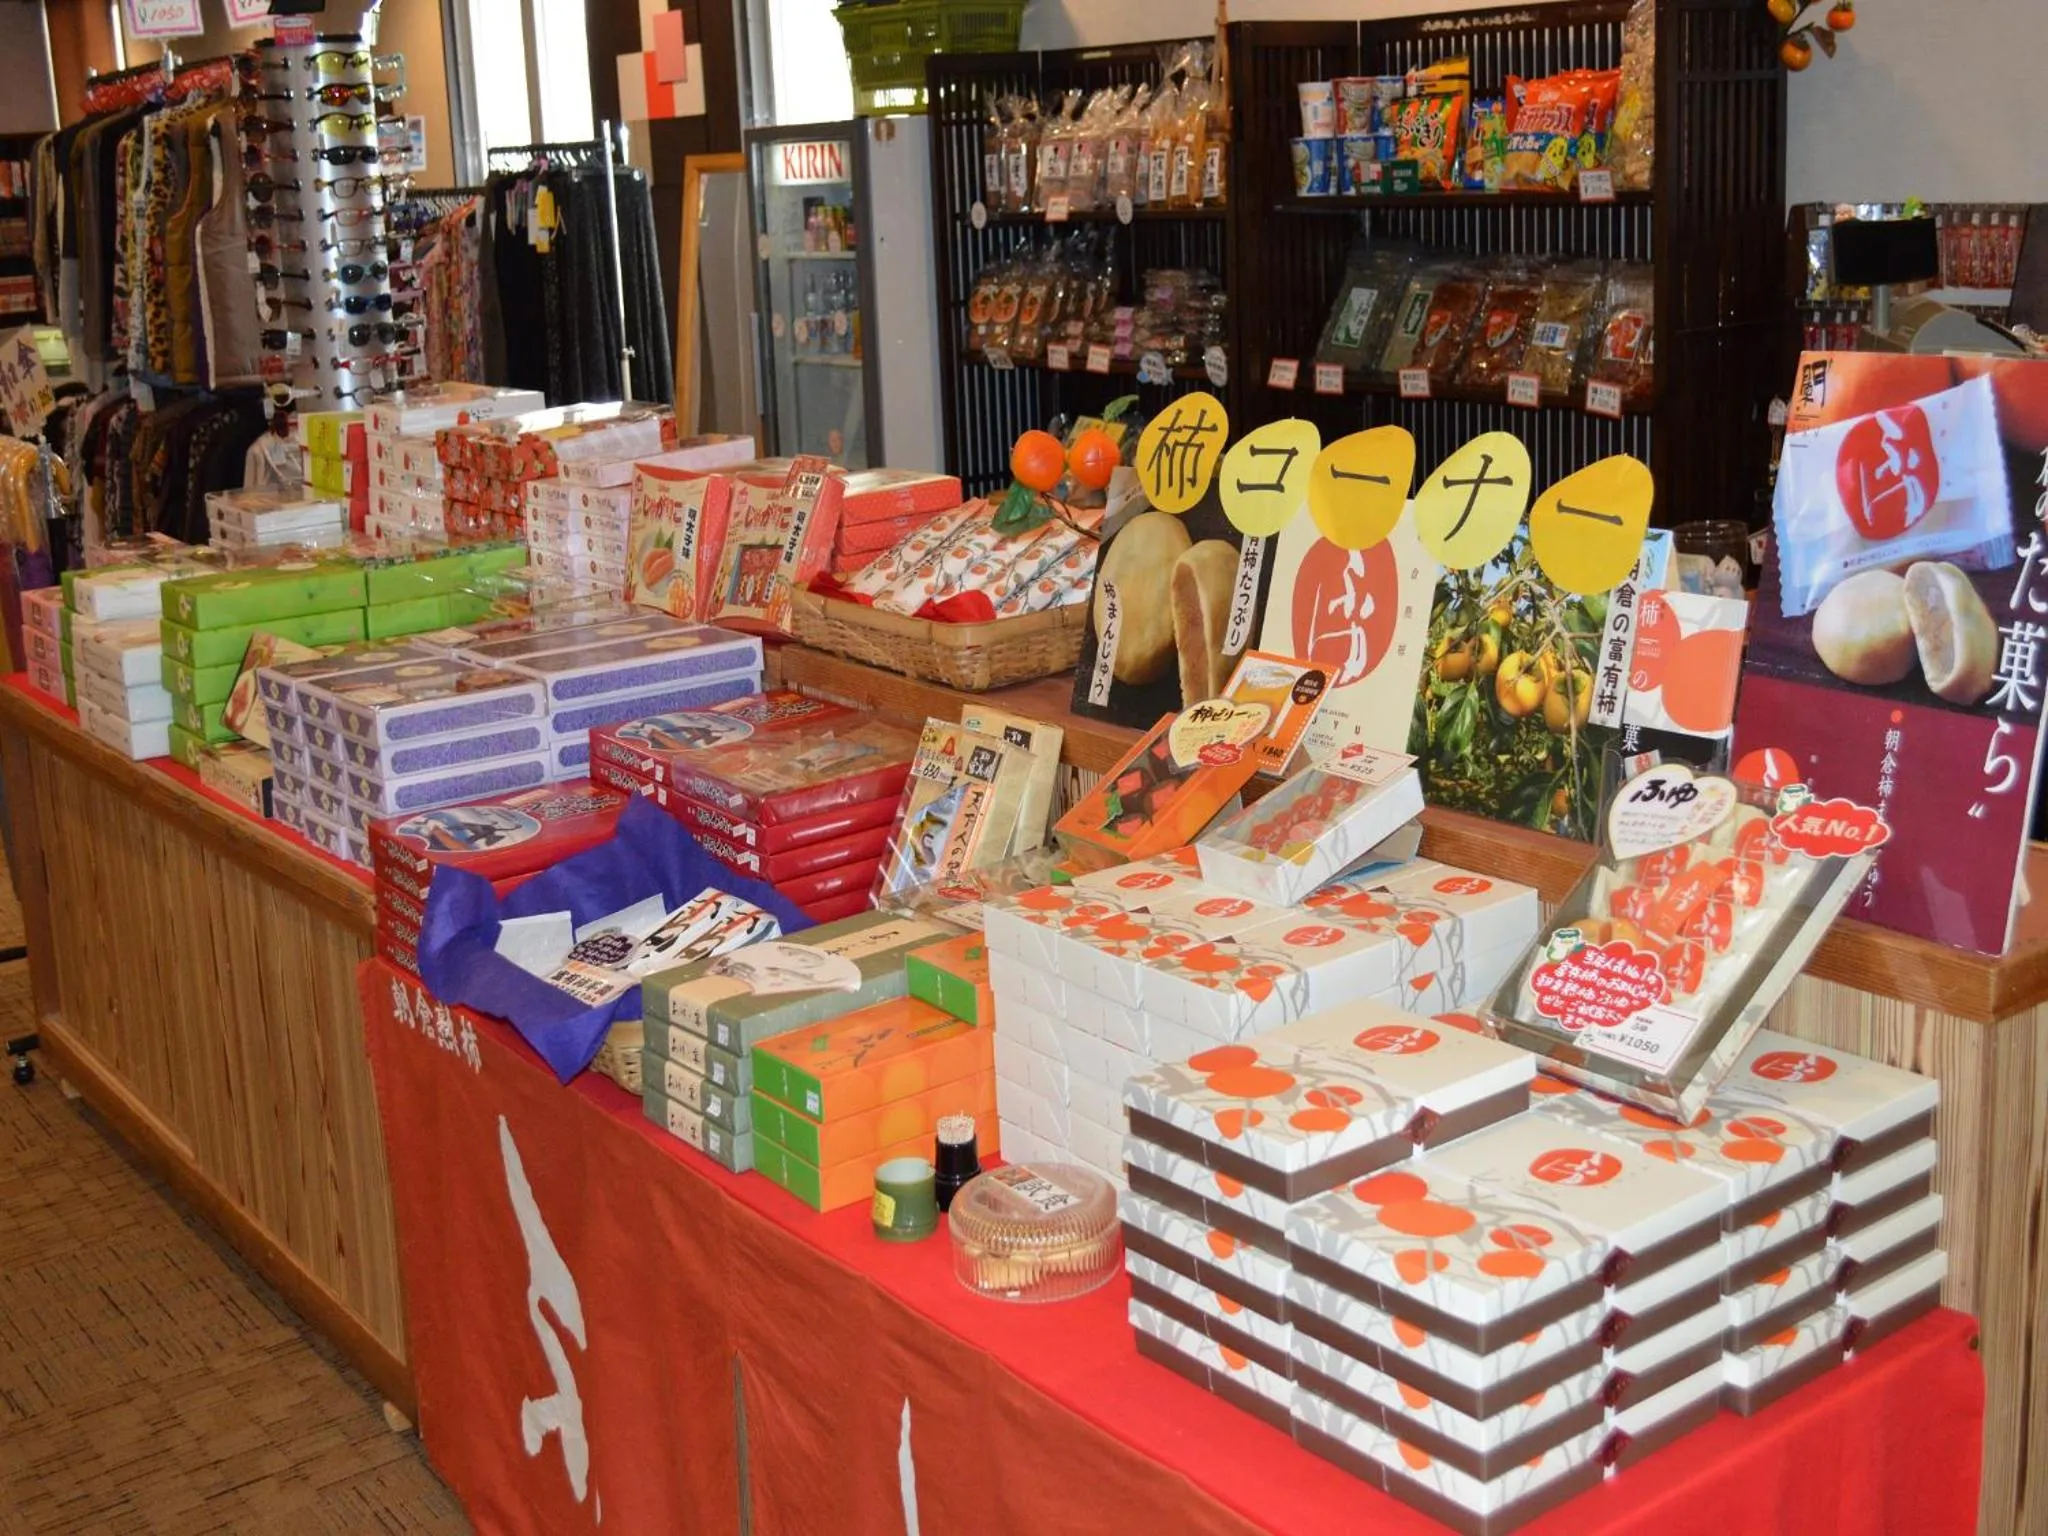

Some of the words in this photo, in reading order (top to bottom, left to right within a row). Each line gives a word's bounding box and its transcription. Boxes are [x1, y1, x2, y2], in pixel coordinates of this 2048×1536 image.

[783, 143, 843, 179] KIRIN
[1630, 778, 1699, 809] ふゆ
[1618, 1032, 1660, 1054] ¥1050
